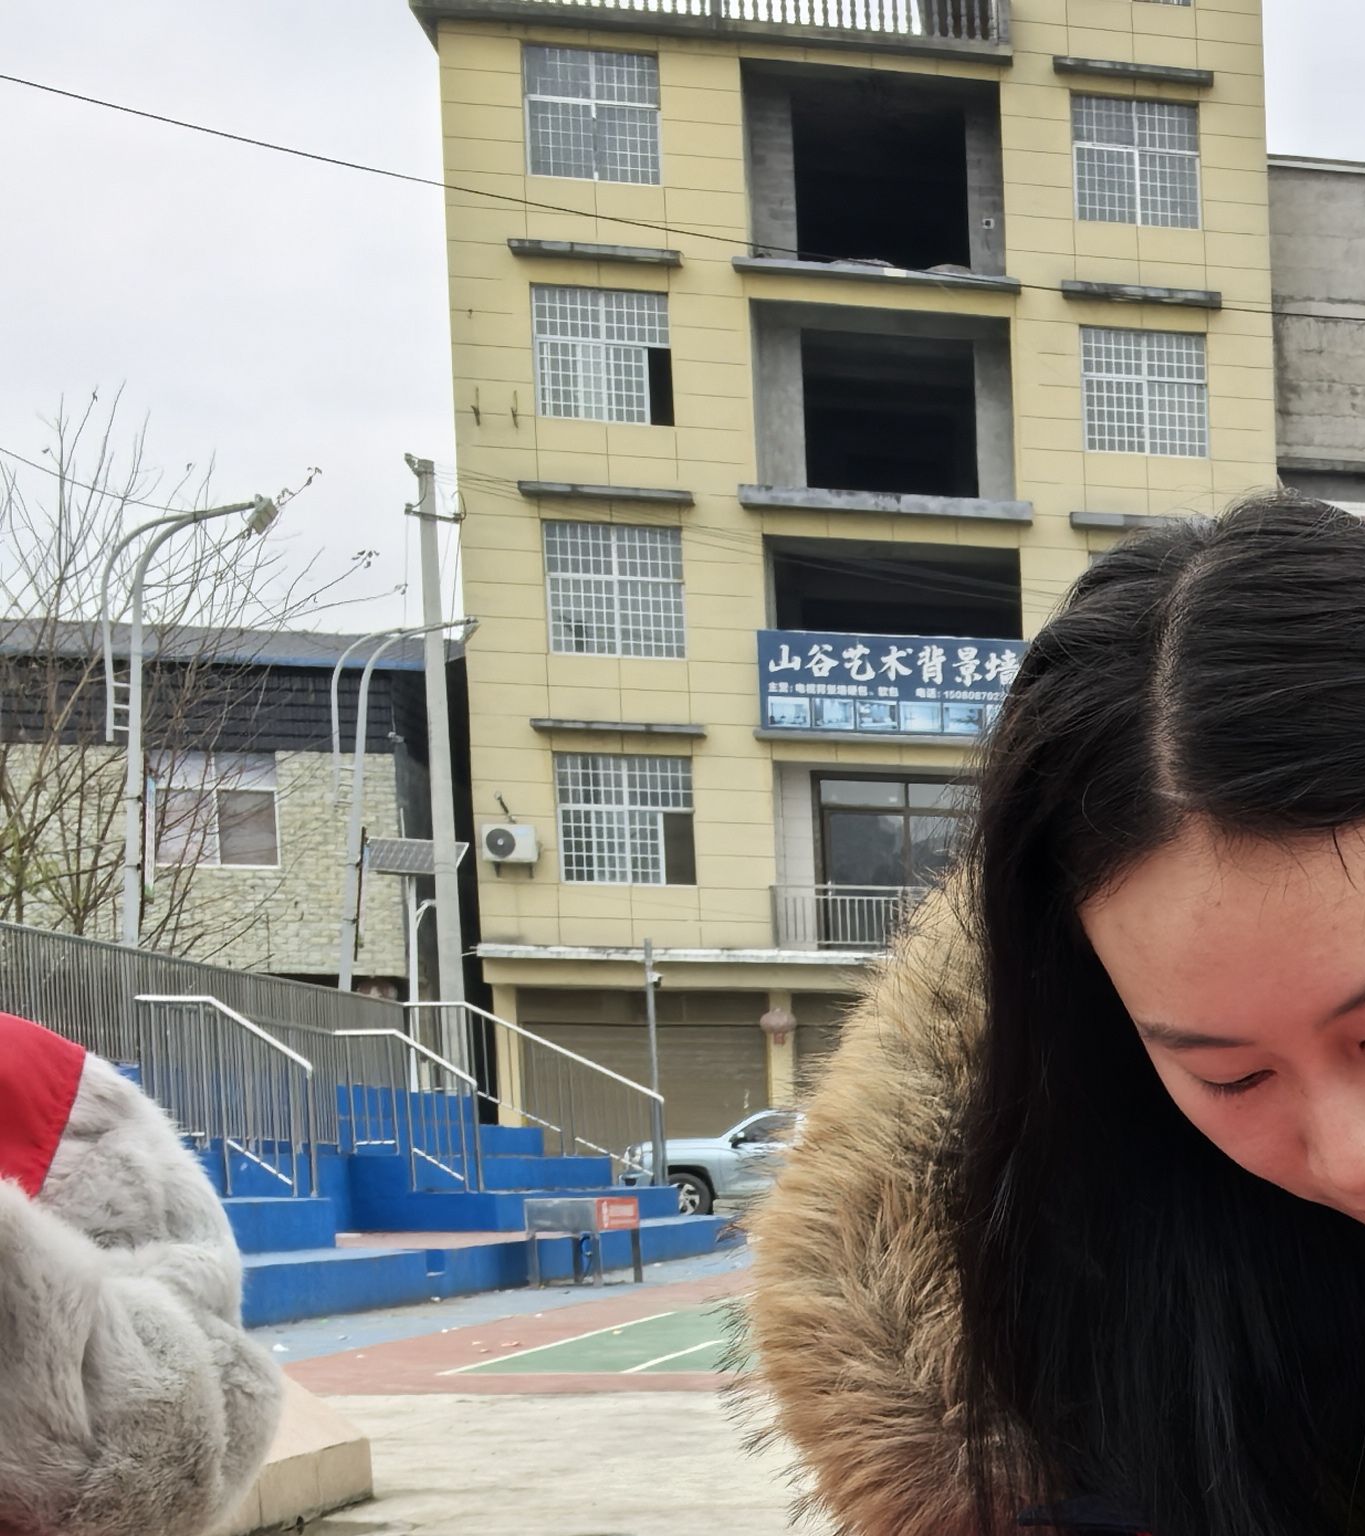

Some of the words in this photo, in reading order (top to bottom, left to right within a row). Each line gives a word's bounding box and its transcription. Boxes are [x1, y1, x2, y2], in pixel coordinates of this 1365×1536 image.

[768, 643, 1020, 687] 山谷艺术背景墙
